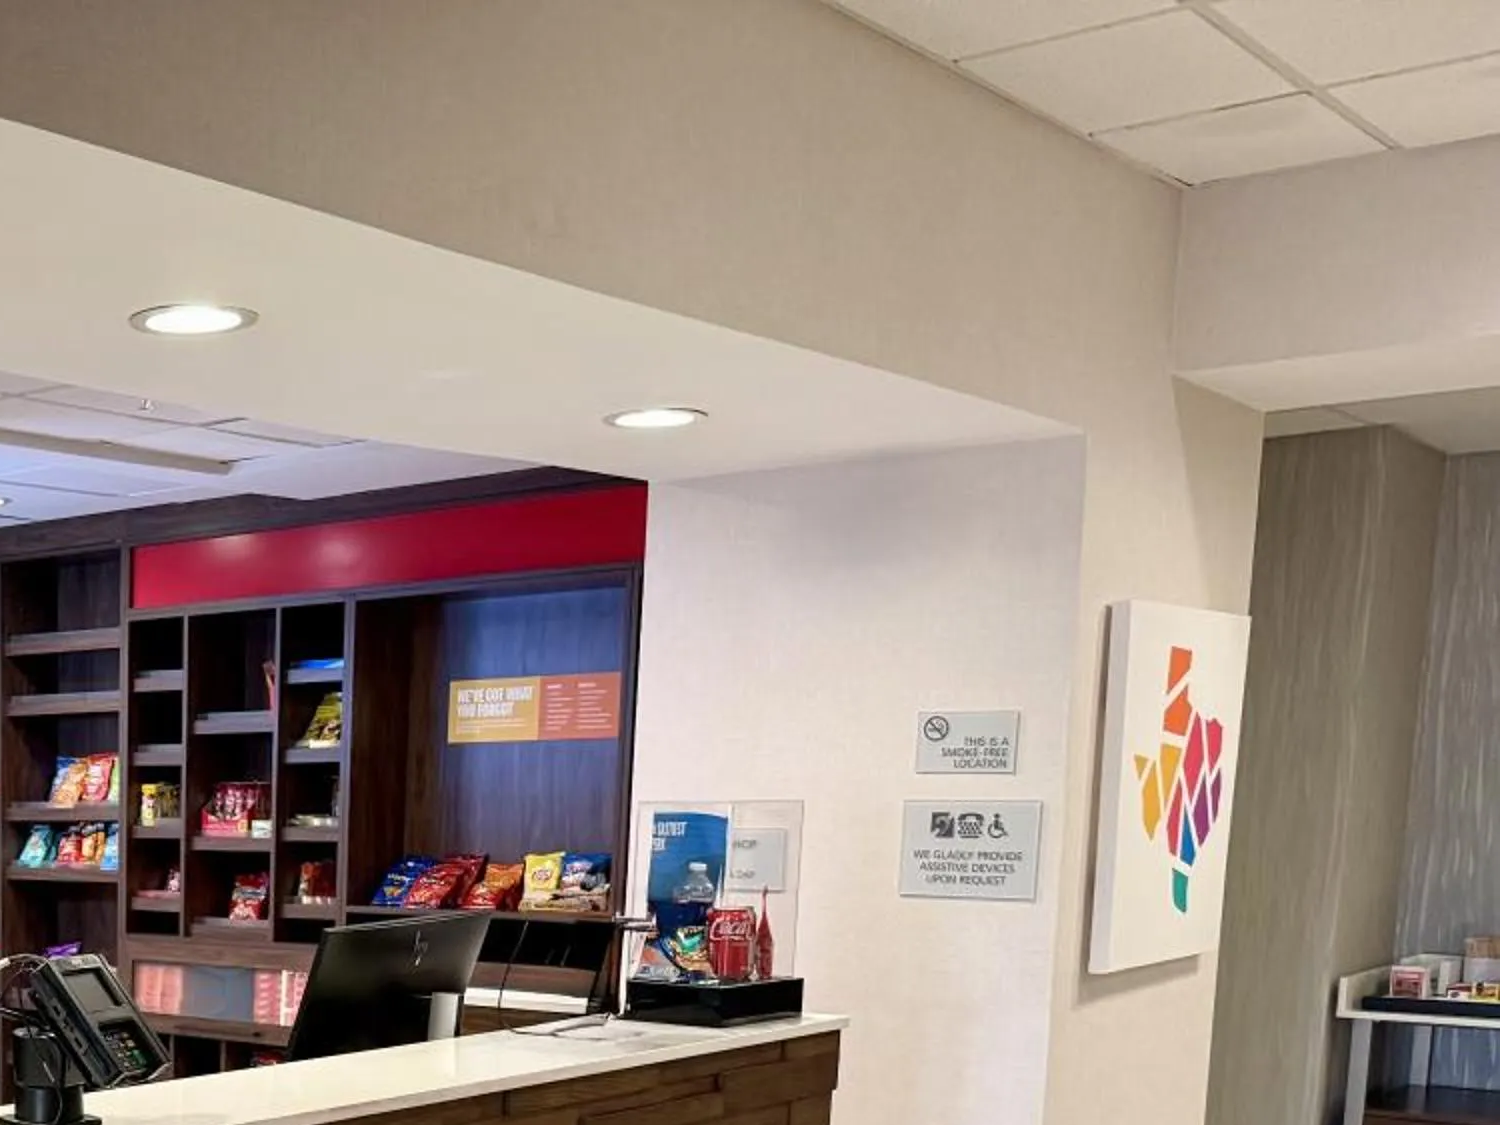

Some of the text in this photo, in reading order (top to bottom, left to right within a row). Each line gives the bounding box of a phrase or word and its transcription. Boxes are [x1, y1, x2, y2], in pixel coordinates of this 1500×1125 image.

[964, 736, 1010, 746] THIS IS A
[941, 747, 1008, 757] SMOKE-FREE
[953, 759, 1007, 768] LOCATION
[913, 850, 1022, 861] WE GLADLY PROVIDE
[920, 862, 1016, 873] ASSISTIVE DEVICES
[925, 874, 1006, 886] UPON REQUEST
